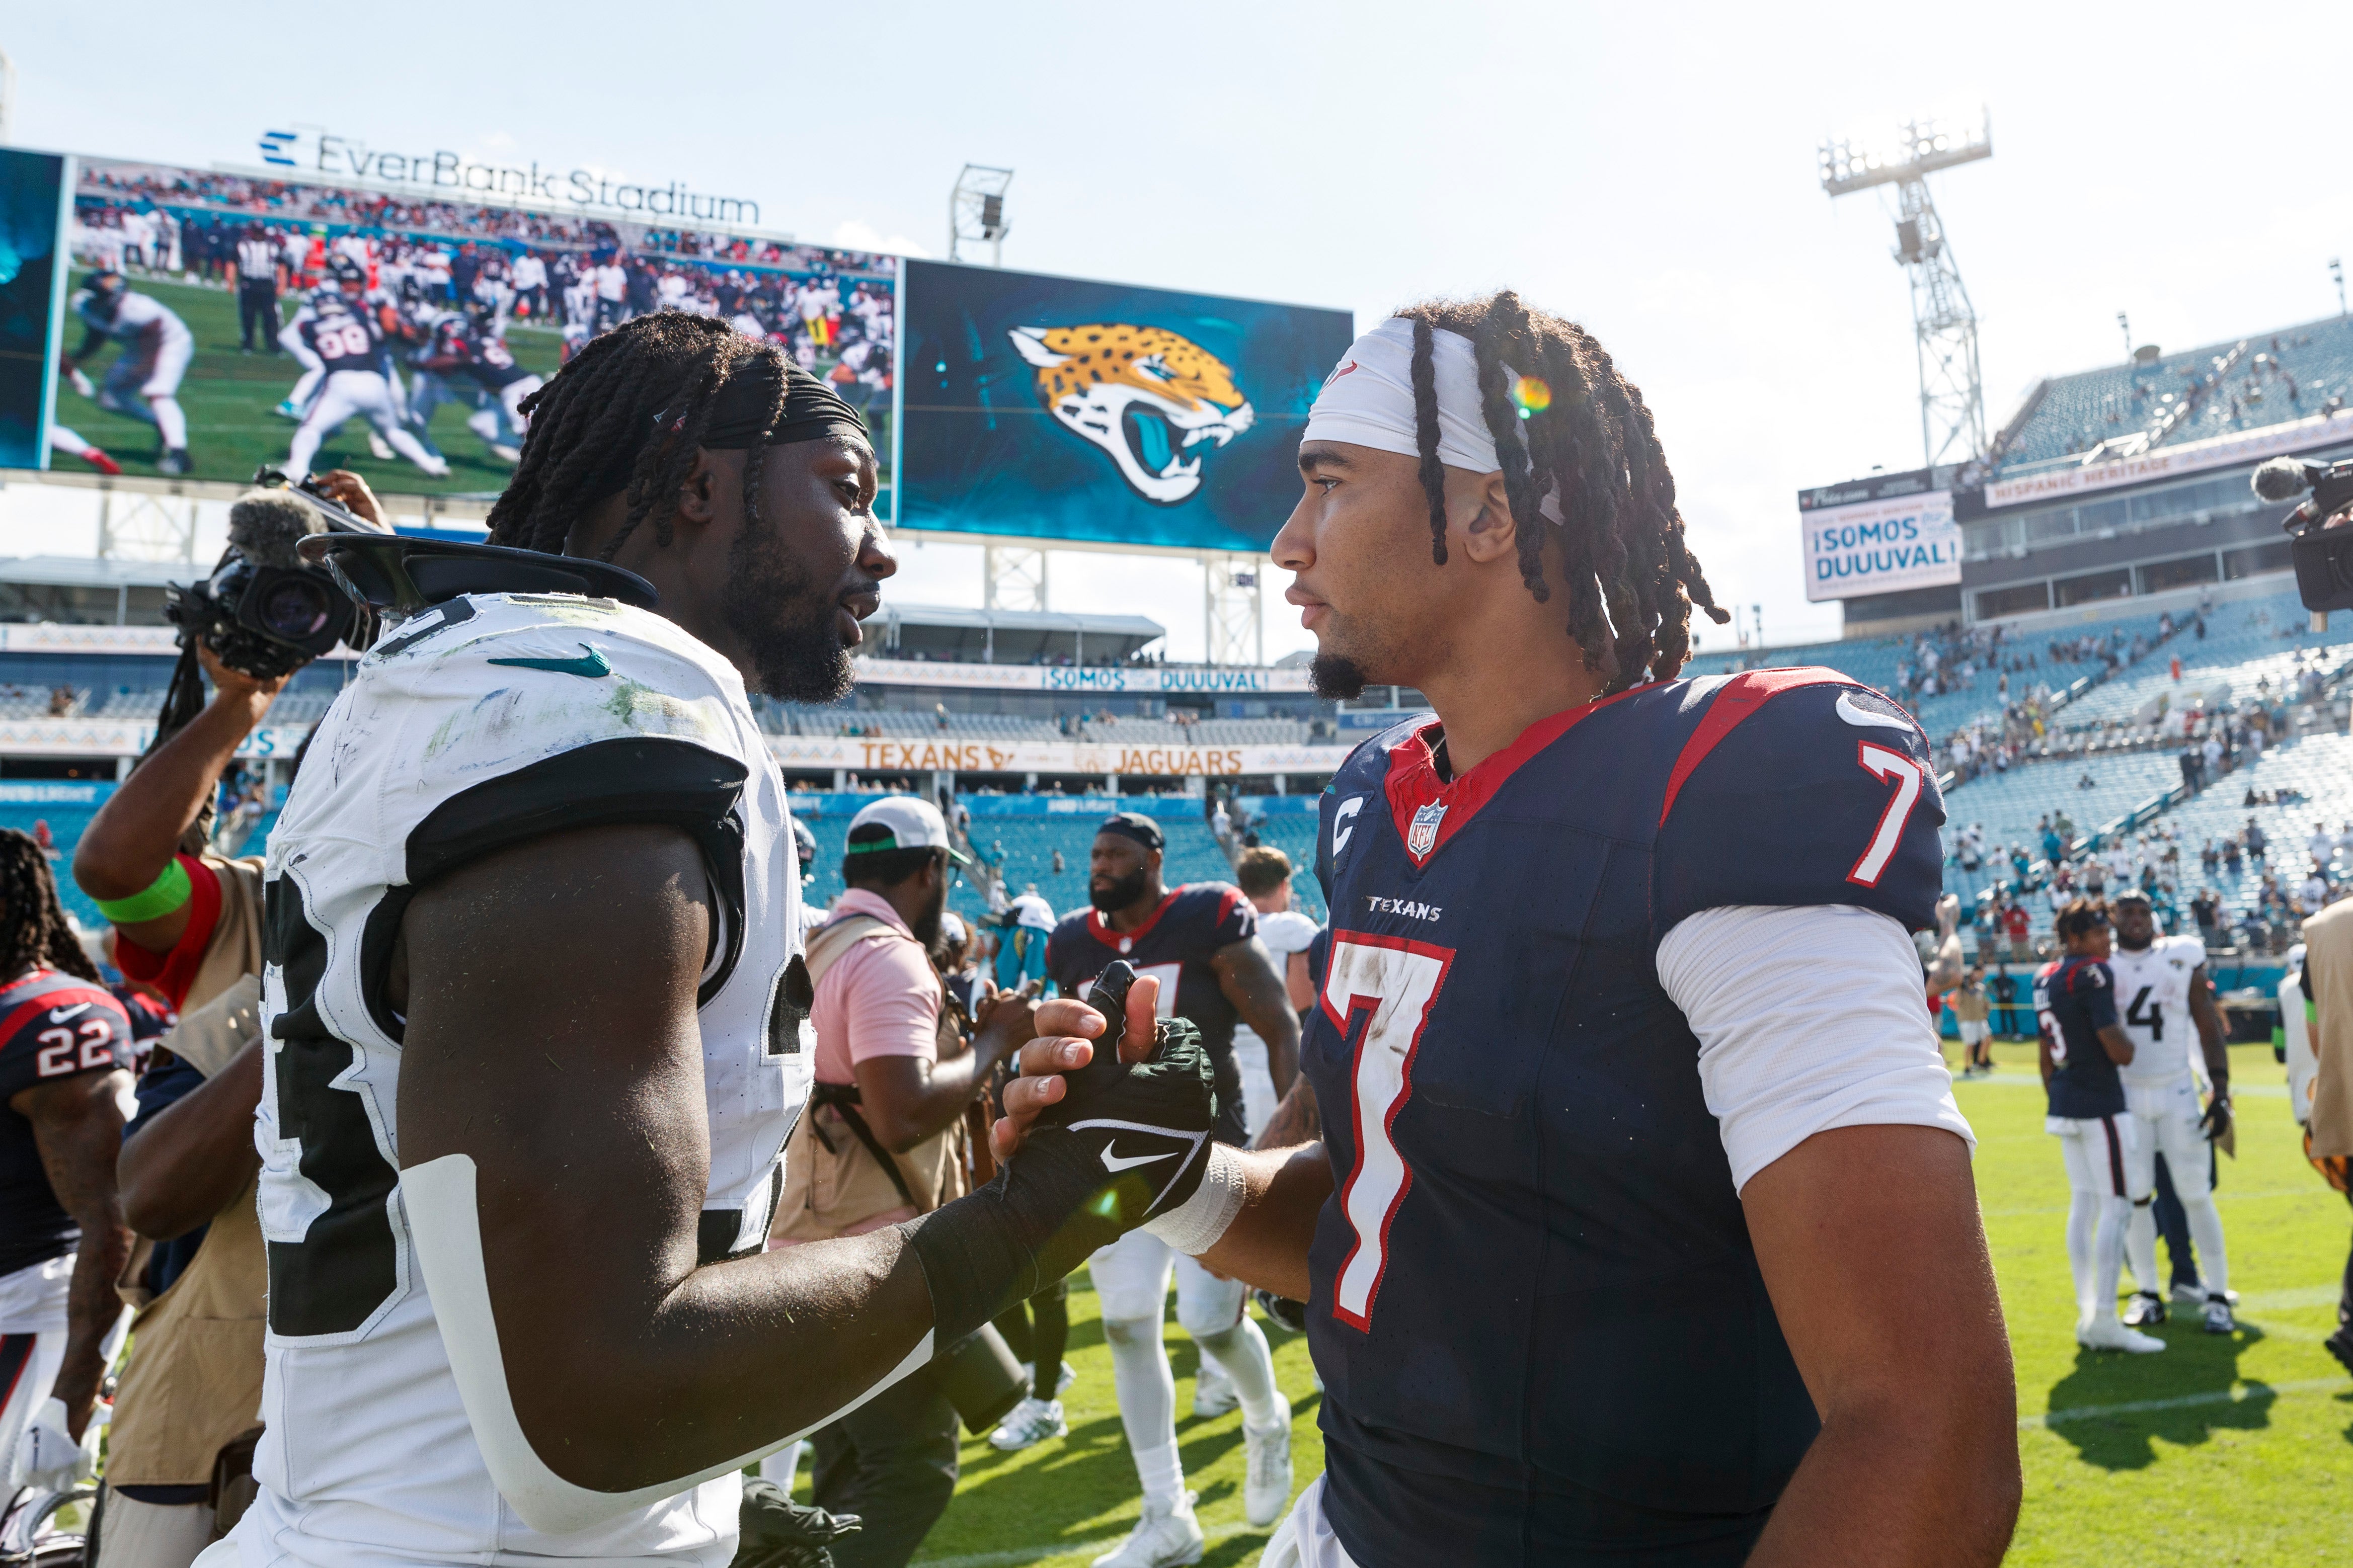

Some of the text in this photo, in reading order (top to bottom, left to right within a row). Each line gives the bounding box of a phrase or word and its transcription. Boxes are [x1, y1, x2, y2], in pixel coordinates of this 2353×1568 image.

[318, 136, 759, 224] EverBank Stadium
[860, 743, 1242, 775] TEXANS JAGUARS
[1334, 796, 1364, 858] C
[1411, 824, 1431, 849] NFL
[1845, 739, 1924, 889] 7
[1365, 895, 1443, 922] TEXANS
[2039, 1009, 2067, 1061] 3
[2127, 984, 2163, 1042] 4
[36, 1017, 114, 1078] 22
[1320, 929, 1457, 1334] 7
